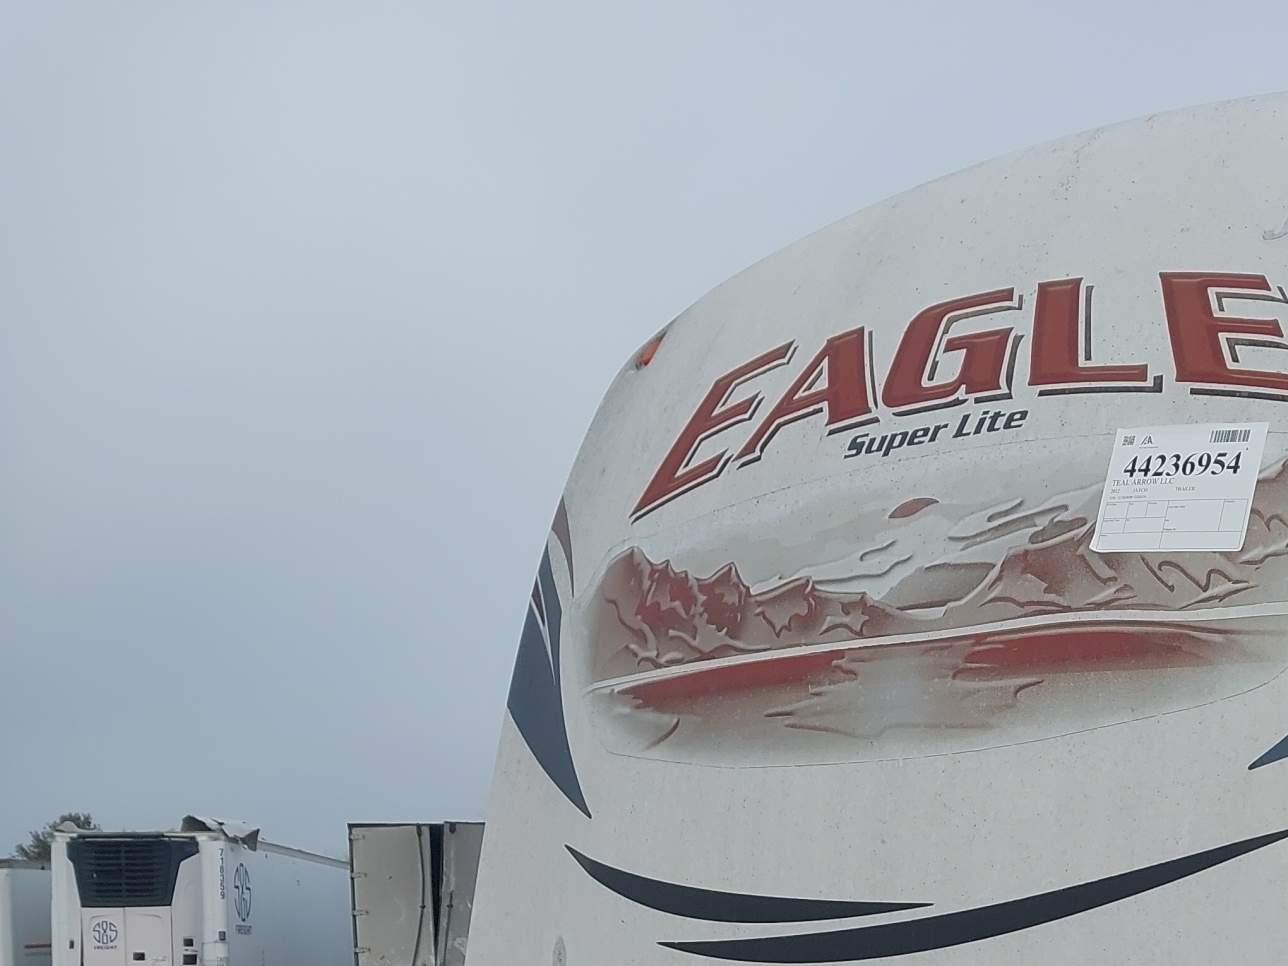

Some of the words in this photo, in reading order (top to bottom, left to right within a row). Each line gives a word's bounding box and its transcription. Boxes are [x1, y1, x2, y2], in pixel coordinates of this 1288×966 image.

[844, 423, 949, 459] Super
[952, 410, 1029, 438] Lite
[1123, 451, 1241, 478] 44236954
[1112, 479, 1129, 487] TEAL
[1131, 477, 1159, 486] ARROW
[1159, 477, 1175, 485] LLC
